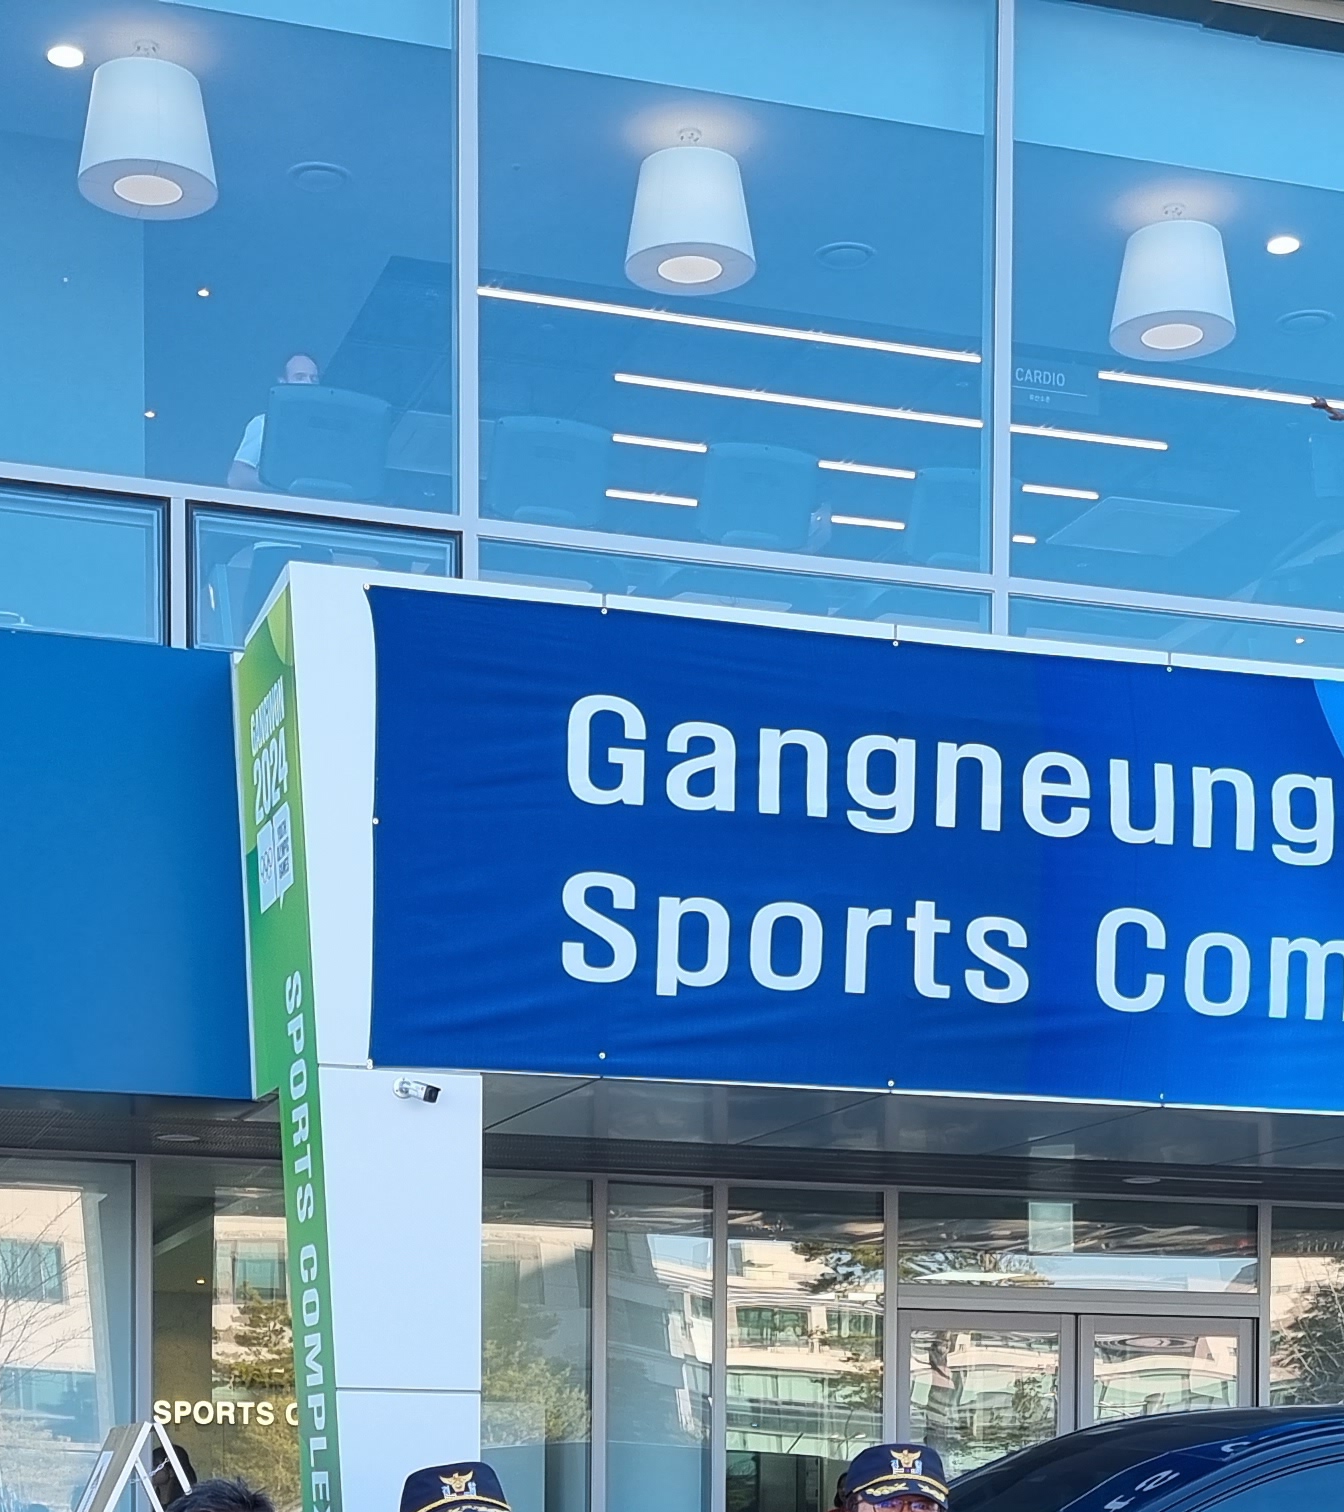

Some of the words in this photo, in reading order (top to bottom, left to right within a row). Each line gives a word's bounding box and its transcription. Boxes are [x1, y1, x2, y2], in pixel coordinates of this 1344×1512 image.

[1015, 367, 1066, 387] CARDIO
[253, 726, 289, 826] 2024
[567, 694, 1335, 866] Gangneung
[562, 871, 1029, 1004] Sports
[285, 970, 314, 1223] SPORTS
[153, 1400, 275, 1426] SPORTS
